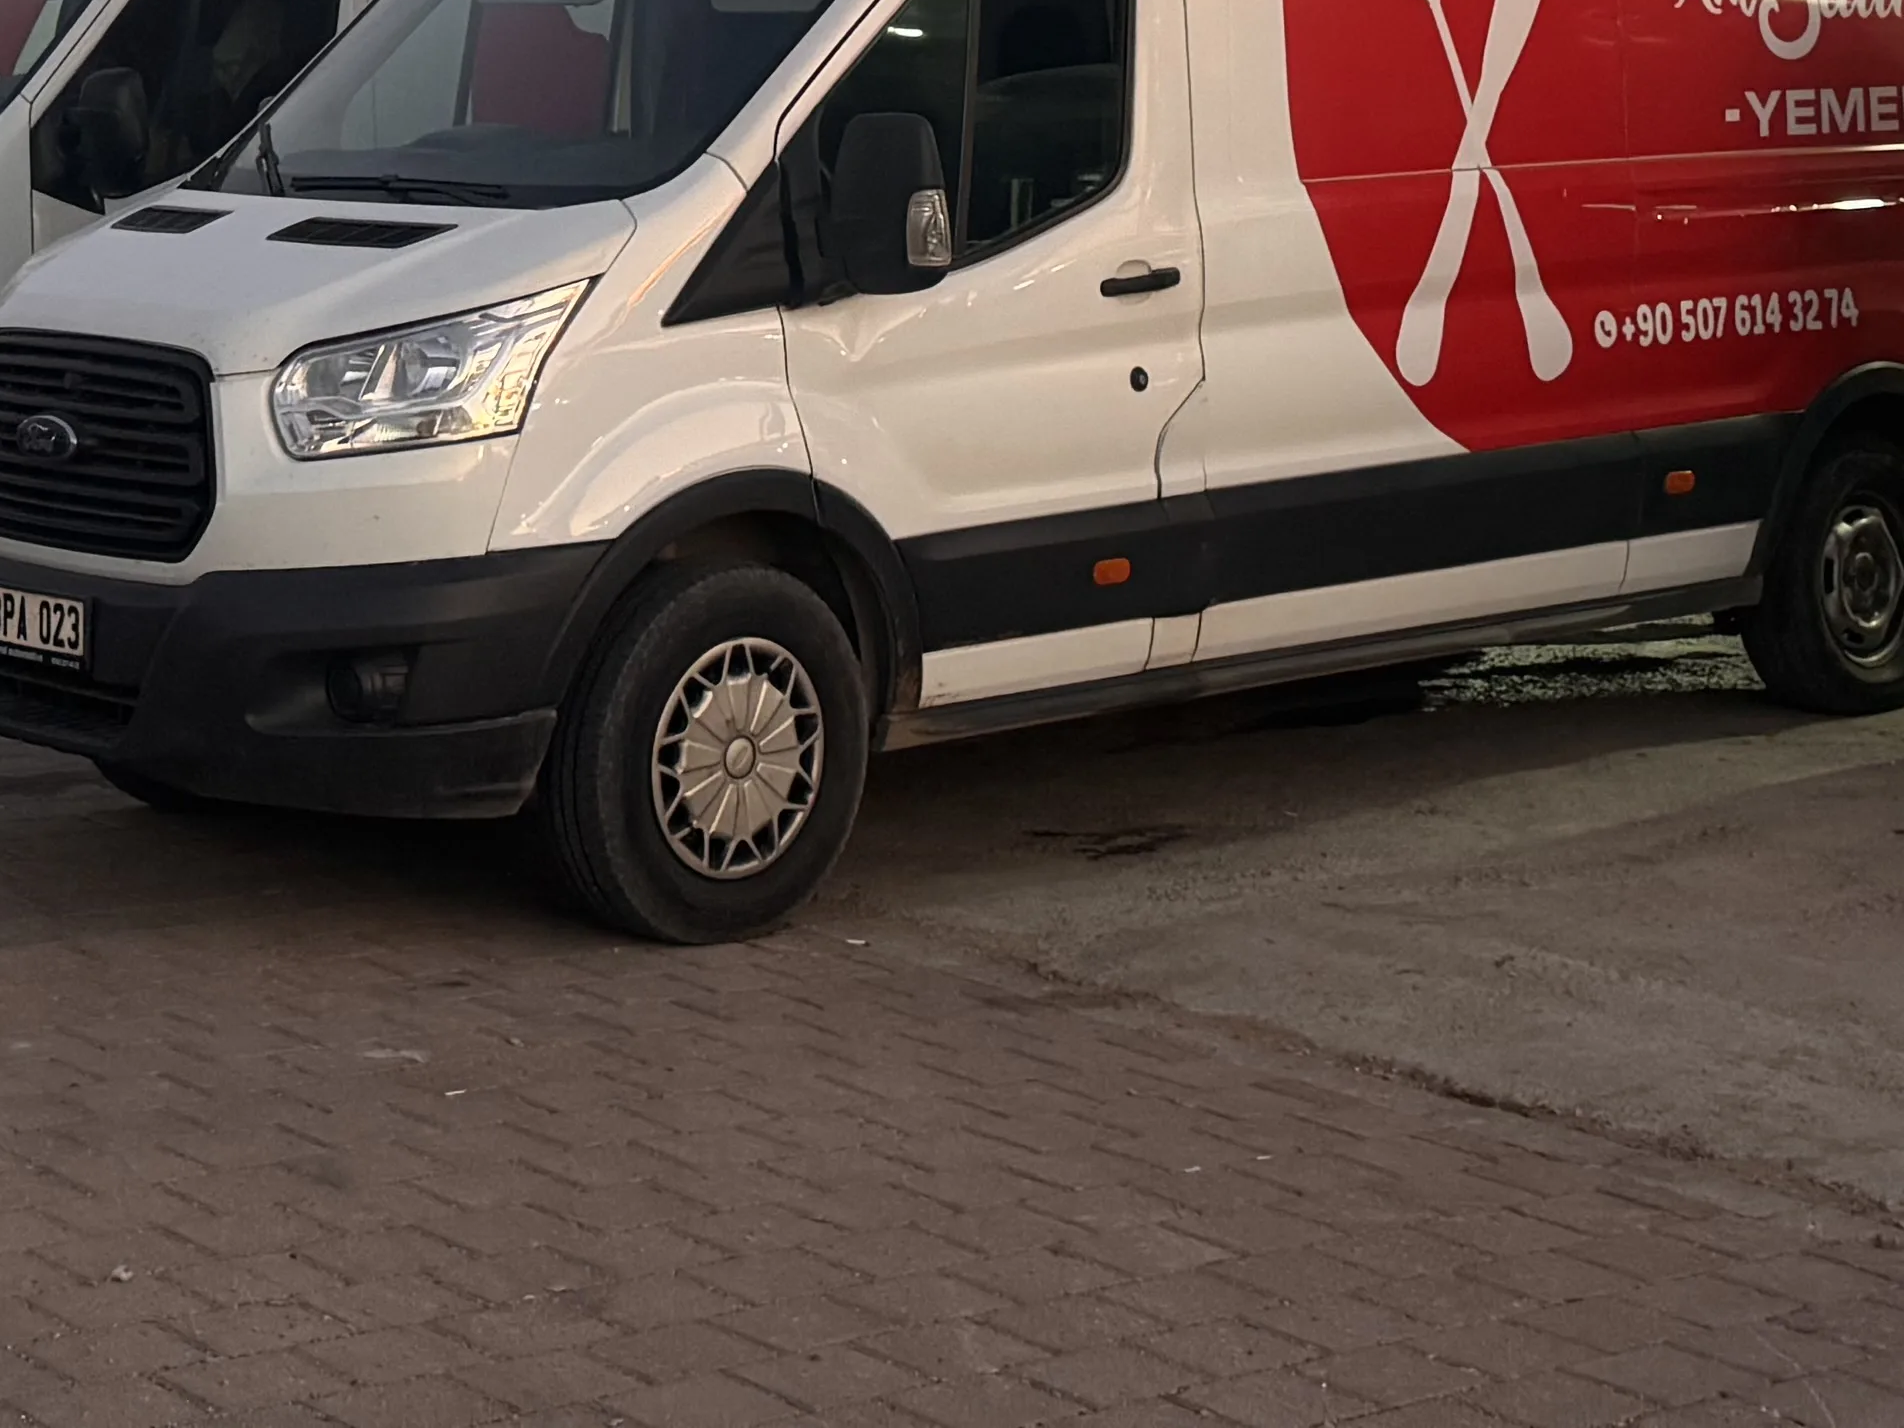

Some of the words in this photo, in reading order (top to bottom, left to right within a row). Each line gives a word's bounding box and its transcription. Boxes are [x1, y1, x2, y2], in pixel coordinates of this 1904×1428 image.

[1622, 302, 1673, 347] +90
[1680, 295, 1728, 342] 507
[1734, 291, 1783, 336] 614
[39, 600, 81, 651] 023
